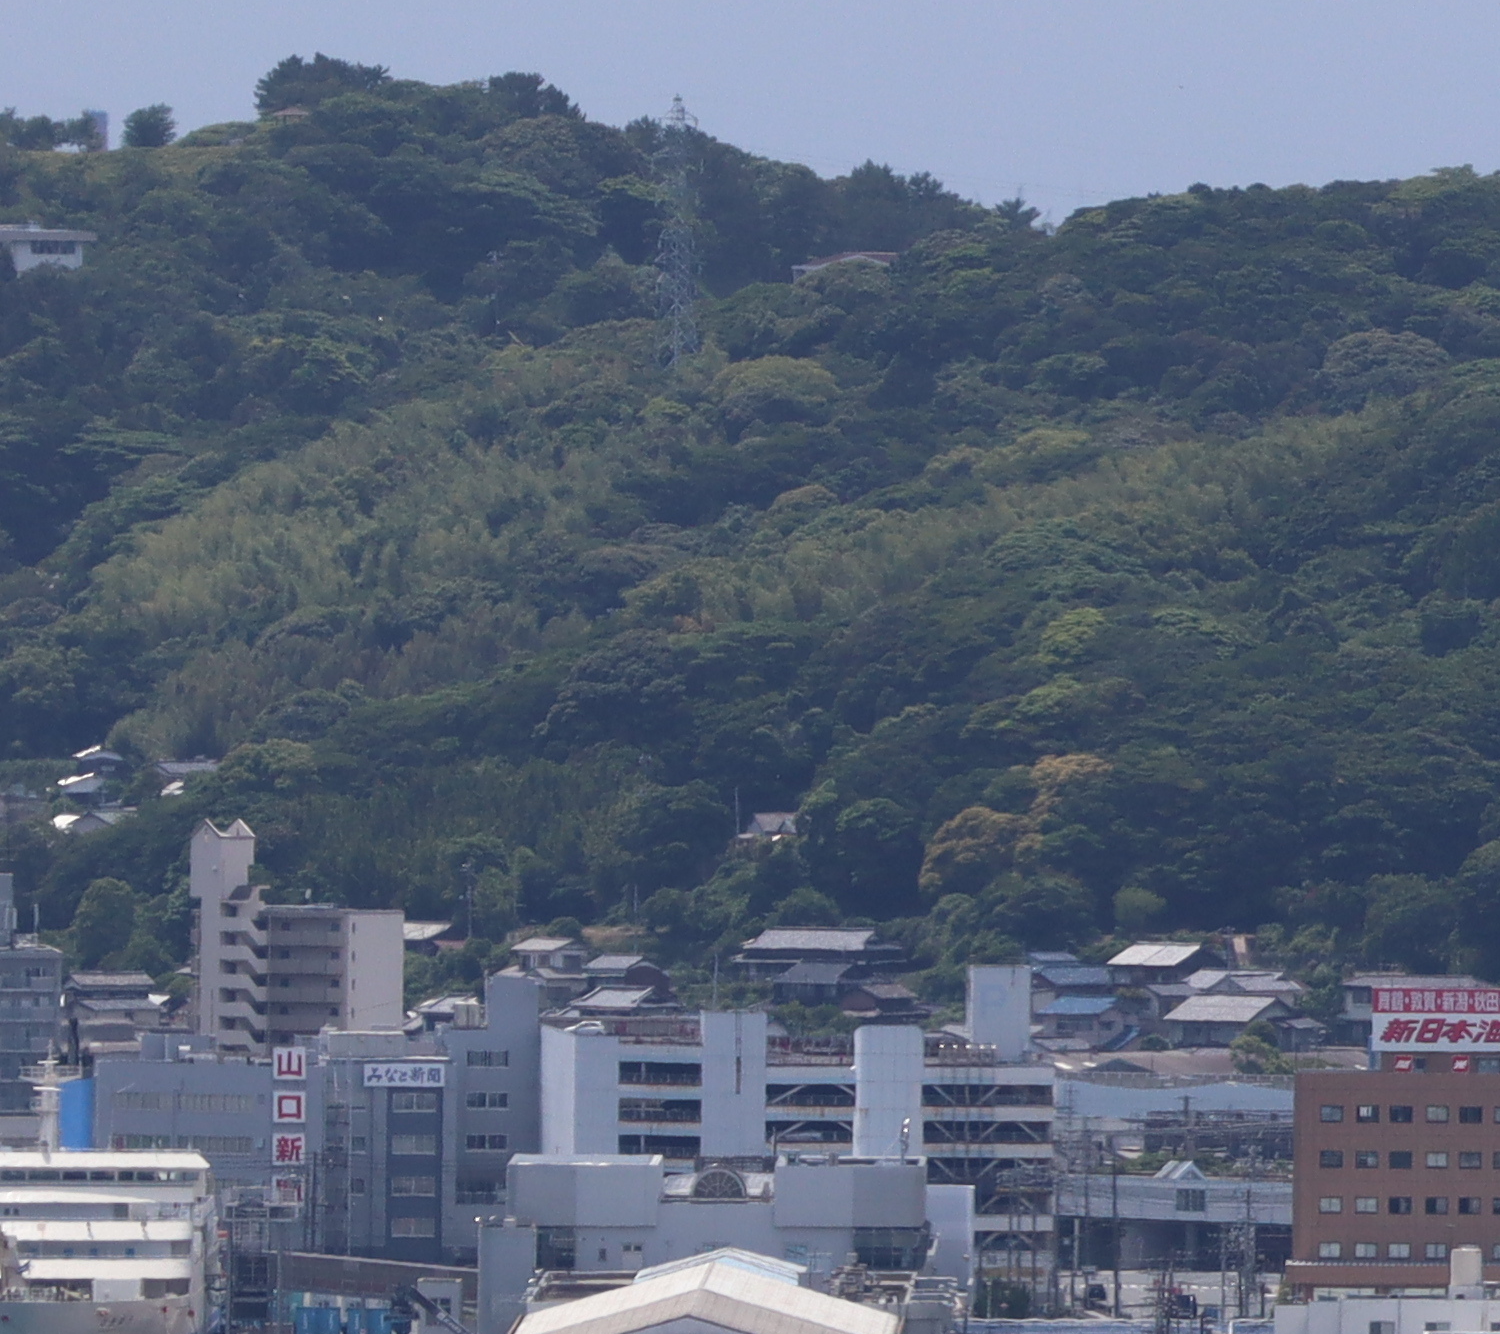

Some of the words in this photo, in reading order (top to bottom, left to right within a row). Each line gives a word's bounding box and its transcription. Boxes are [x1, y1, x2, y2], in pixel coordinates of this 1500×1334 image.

[366, 1068, 442, 1084] みなと新聞
